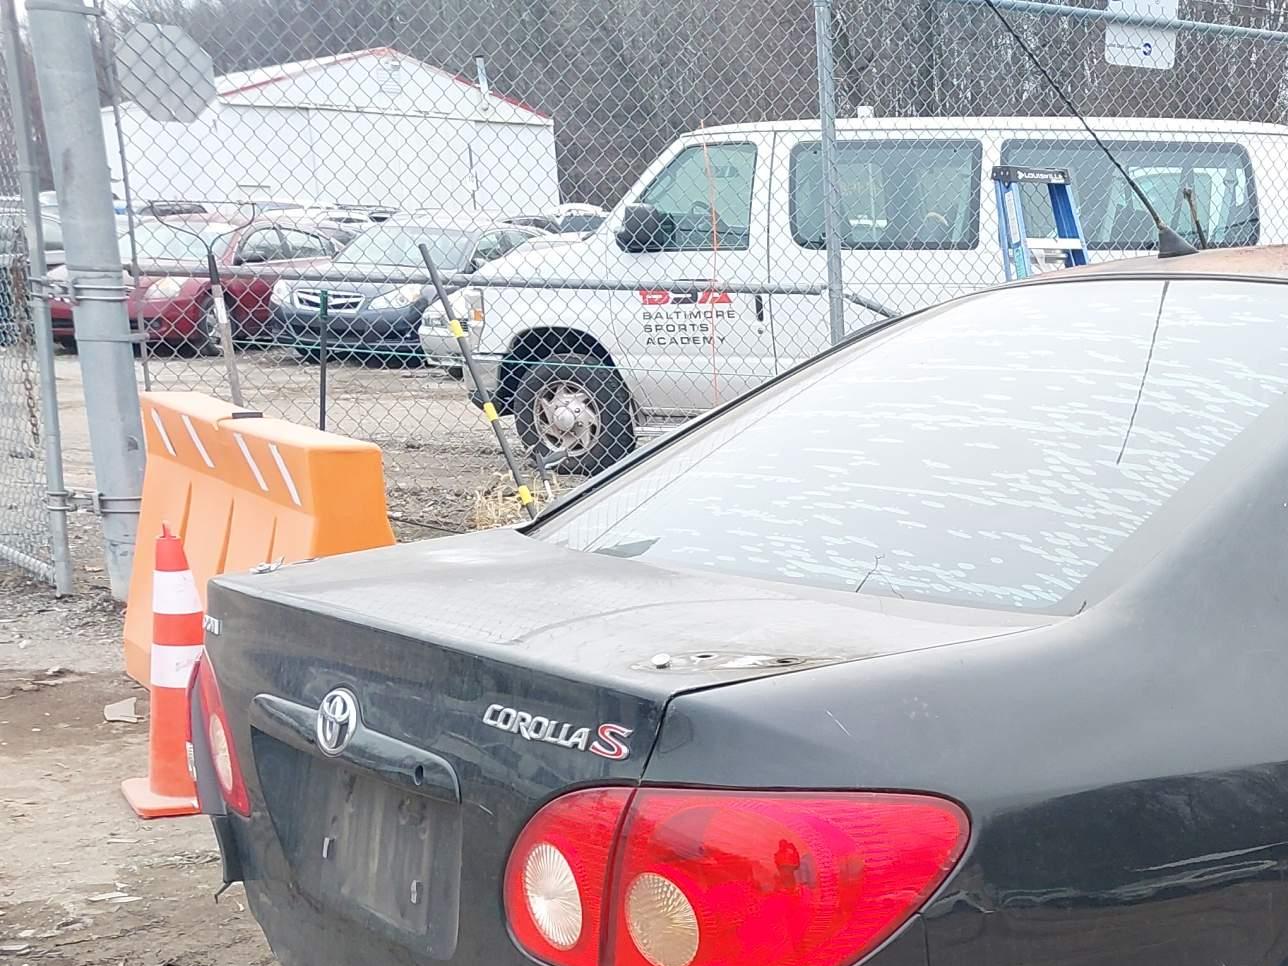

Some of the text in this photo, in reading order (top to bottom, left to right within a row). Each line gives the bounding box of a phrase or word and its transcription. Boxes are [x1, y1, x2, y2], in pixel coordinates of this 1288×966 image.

[643, 311, 736, 320] BALTIMORE
[644, 324, 709, 333] SPORTS
[646, 337, 727, 346] ACADEMY
[482, 703, 634, 760] COROLLA S
